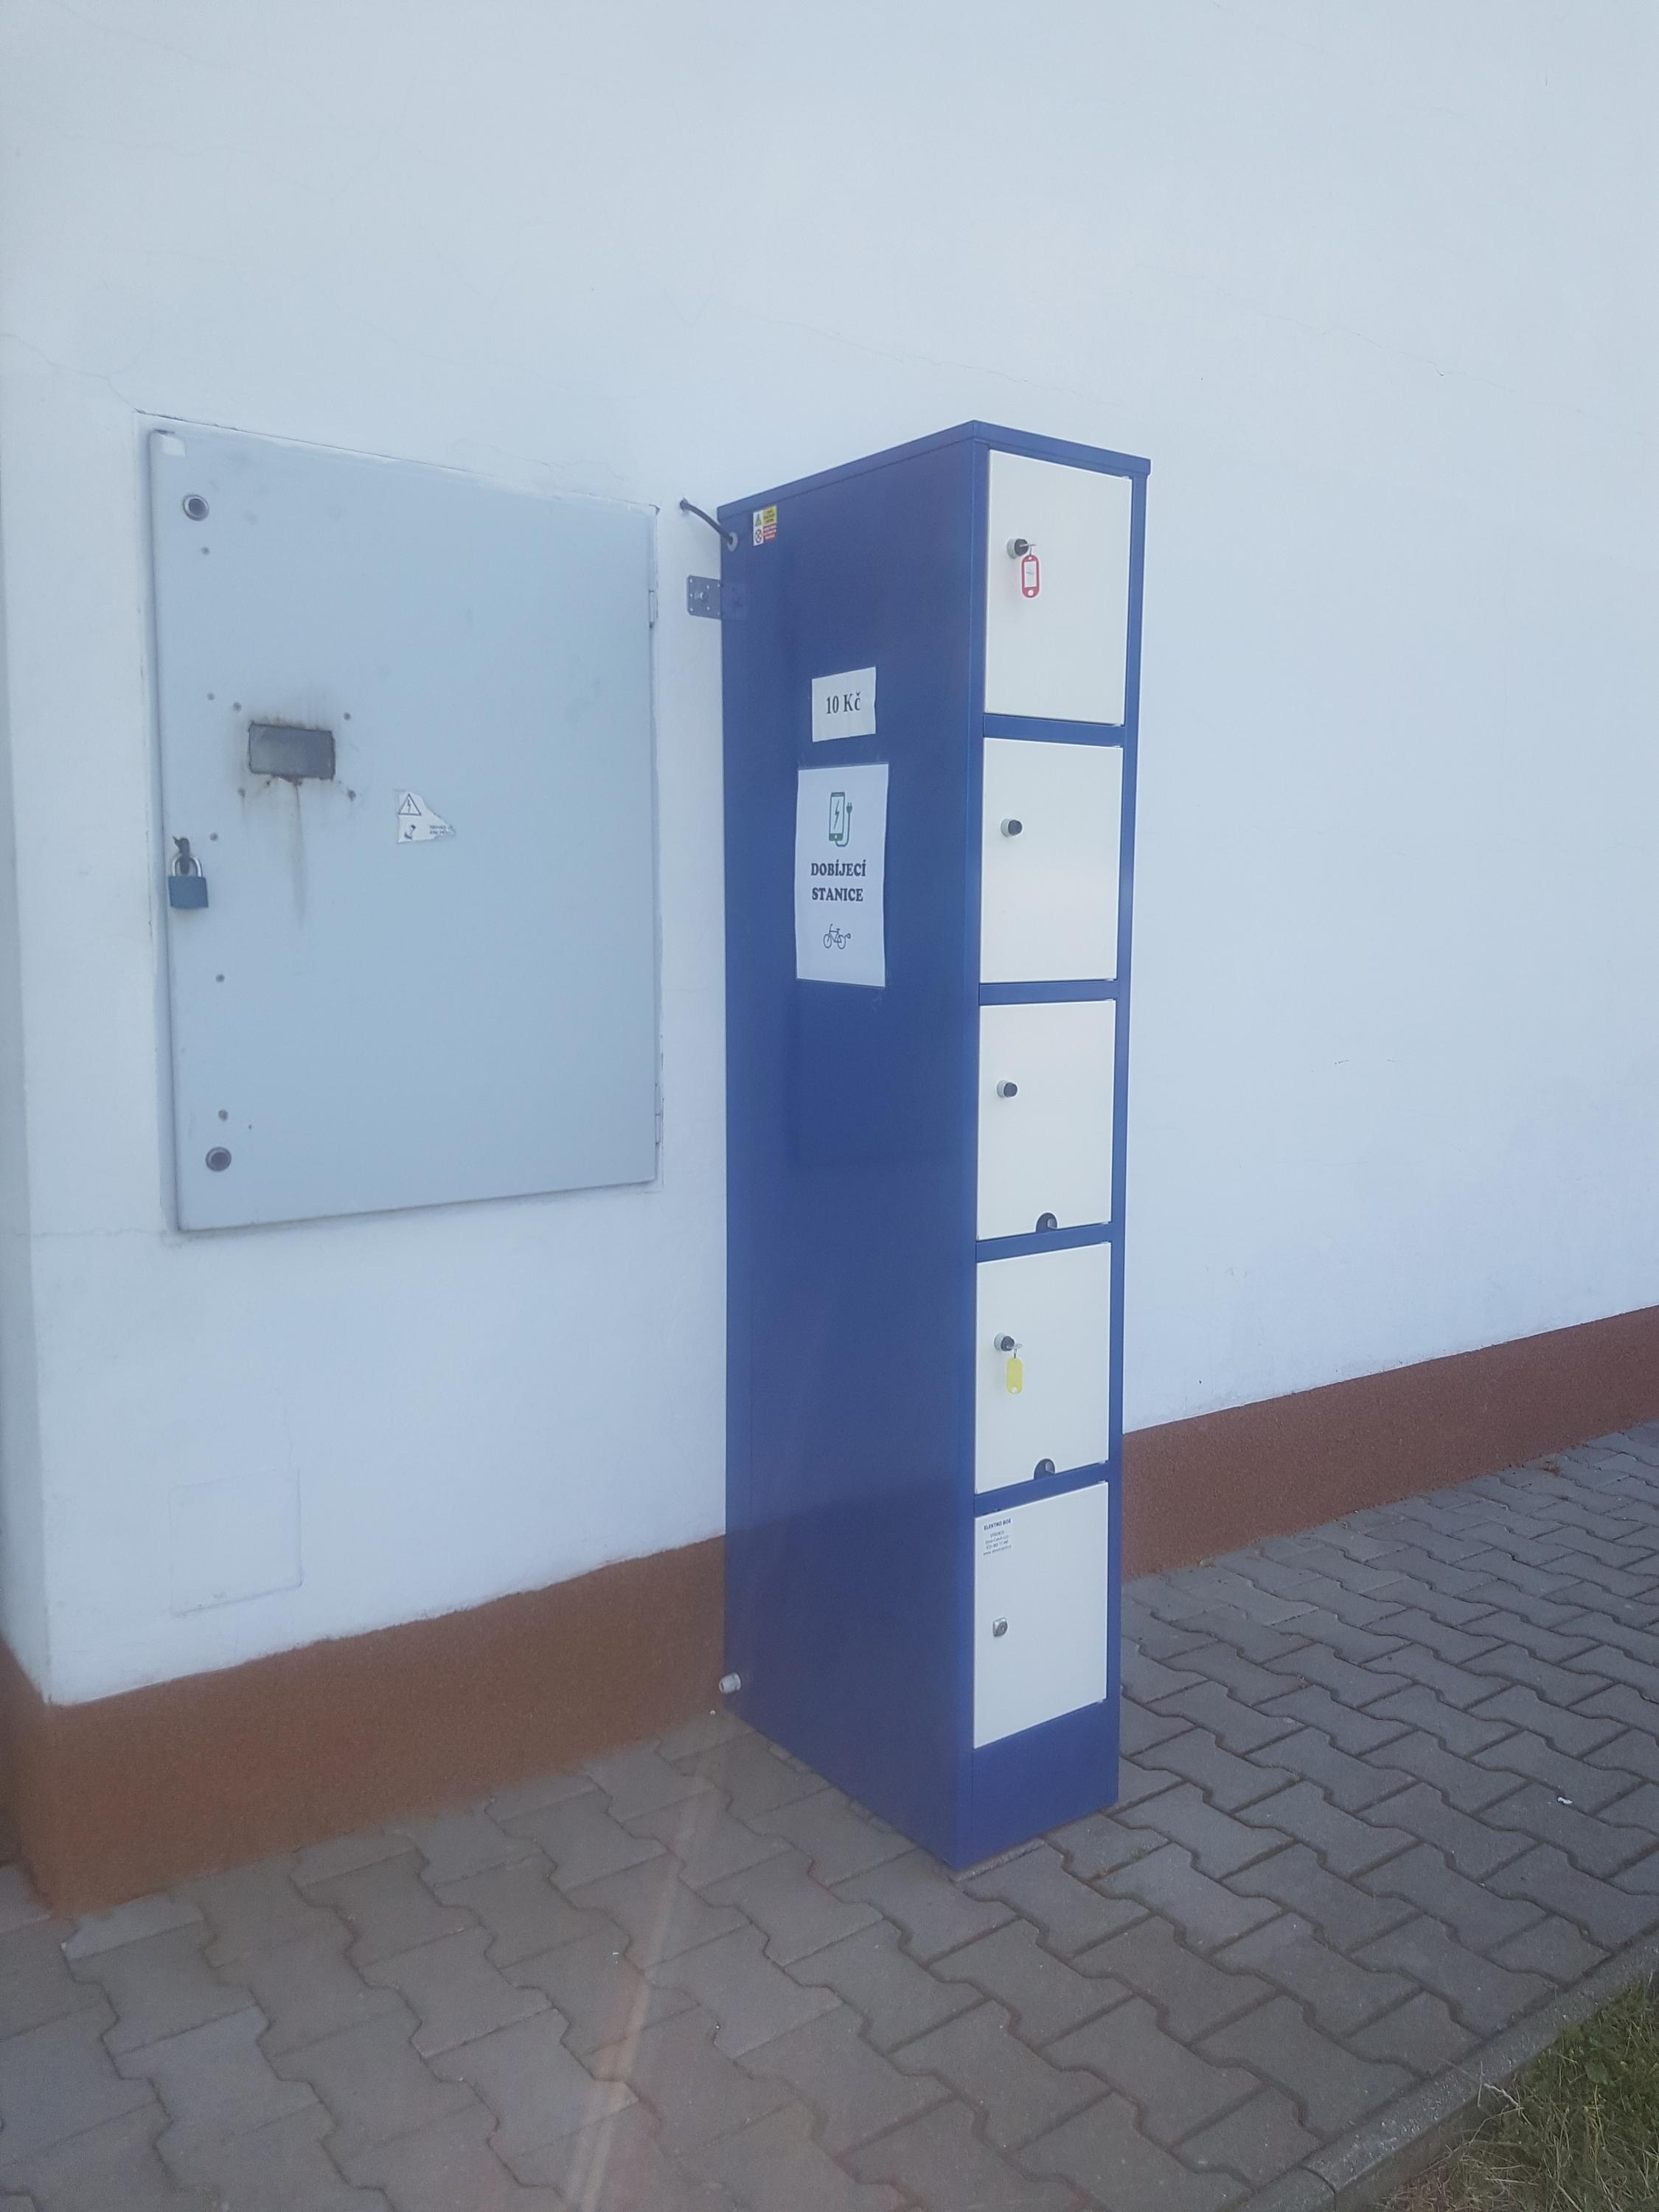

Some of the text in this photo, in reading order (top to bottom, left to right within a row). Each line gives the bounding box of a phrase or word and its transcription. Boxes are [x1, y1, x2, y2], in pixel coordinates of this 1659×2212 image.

[827, 691, 861, 714] 10 Kč
[810, 859, 866, 877] DOBÍJECÍ
[812, 887, 864, 902] STANICE
[984, 1520, 1002, 1531] ELEKTRO
